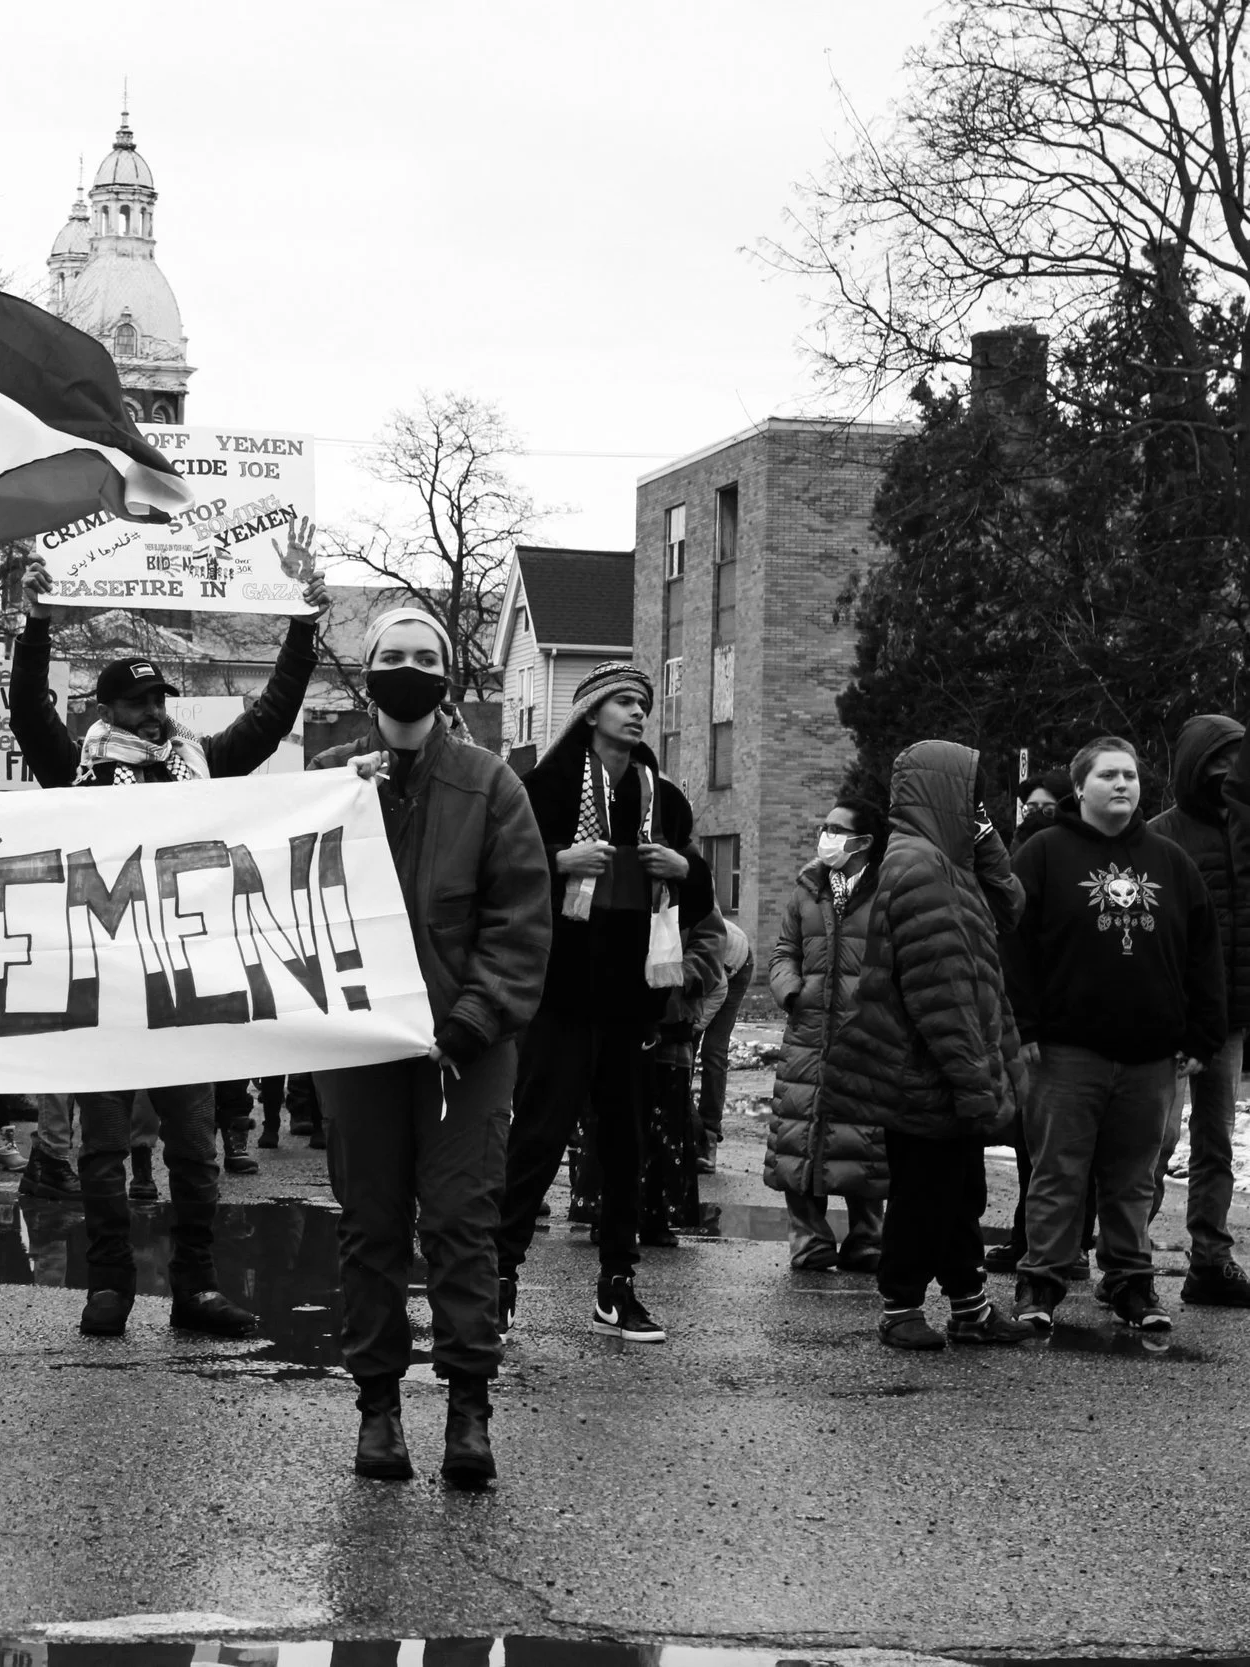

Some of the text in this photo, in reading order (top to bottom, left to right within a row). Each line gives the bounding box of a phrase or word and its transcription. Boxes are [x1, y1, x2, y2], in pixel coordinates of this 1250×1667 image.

[144, 432, 304, 456] OFF YEMEN
[170, 458, 281, 480] CIDE JOE
[42, 508, 116, 550] CRIM
[167, 498, 227, 535] STOP
[213, 503, 299, 548] YEMEN
[200, 581, 227, 598] IN
[241, 583, 303, 600] GAZA
